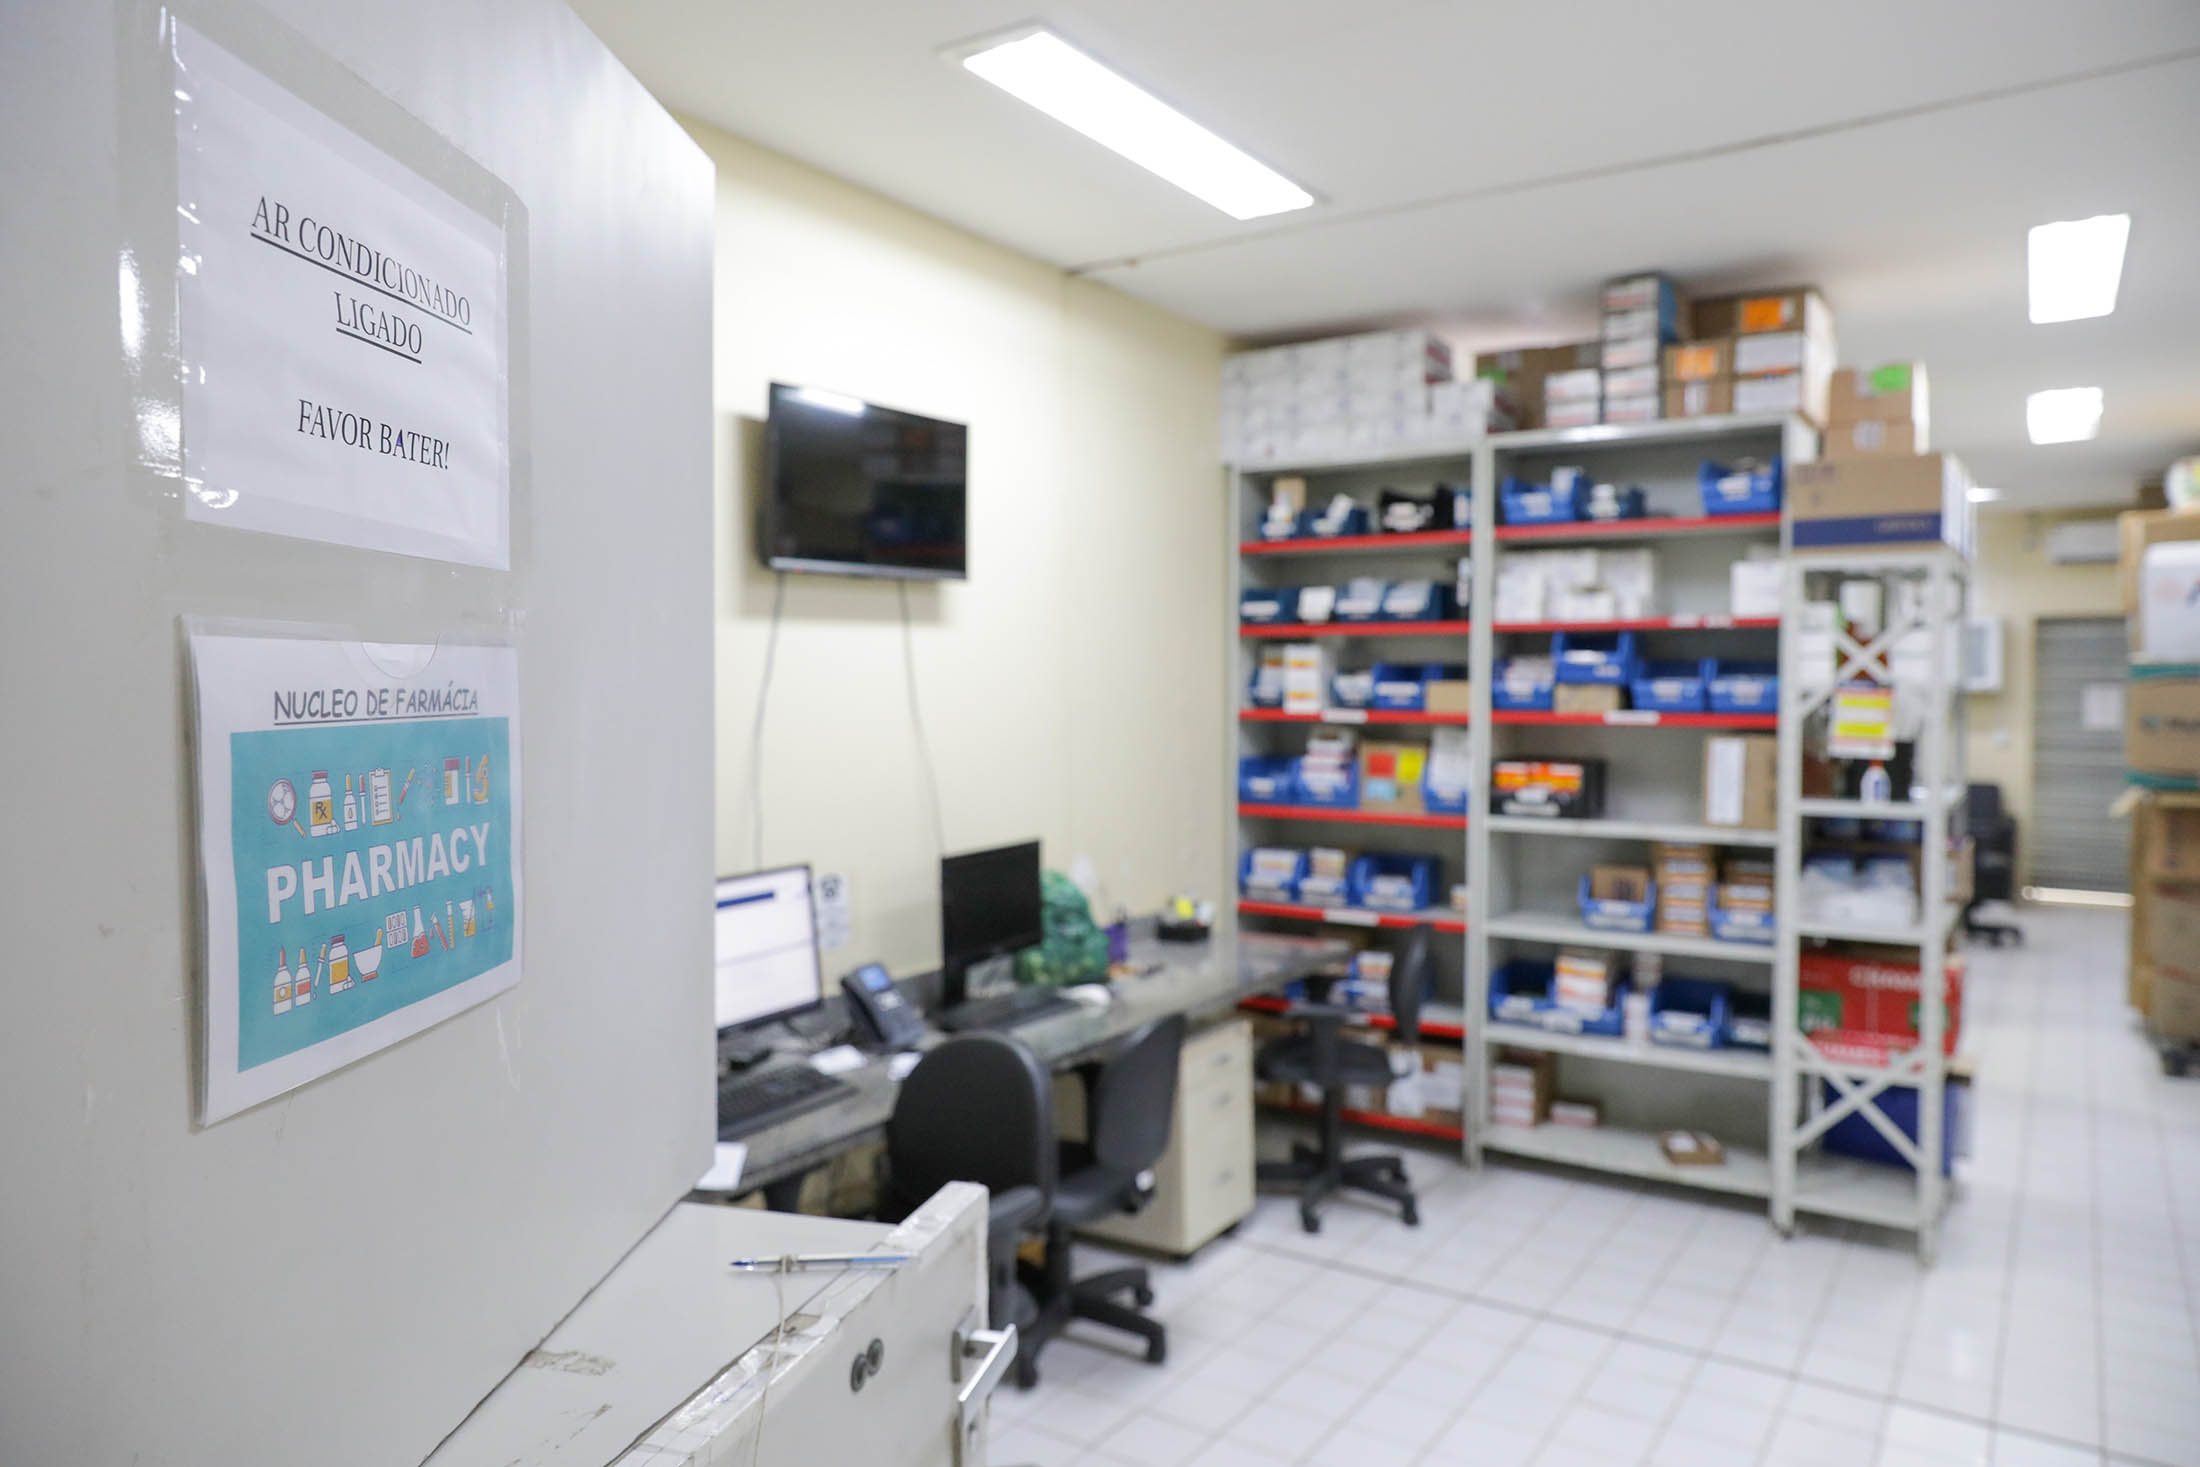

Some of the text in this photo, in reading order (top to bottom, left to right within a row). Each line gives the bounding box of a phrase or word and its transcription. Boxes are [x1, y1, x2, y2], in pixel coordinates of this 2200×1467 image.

[252, 196, 470, 326] AR CONDICIONADO
[334, 291, 422, 354] LIGADO
[298, 399, 449, 469] FAVOR BATER!
[274, 680, 478, 720] NUCLEO DE FARMÁCIA
[267, 822, 490, 924] PHARMACY
